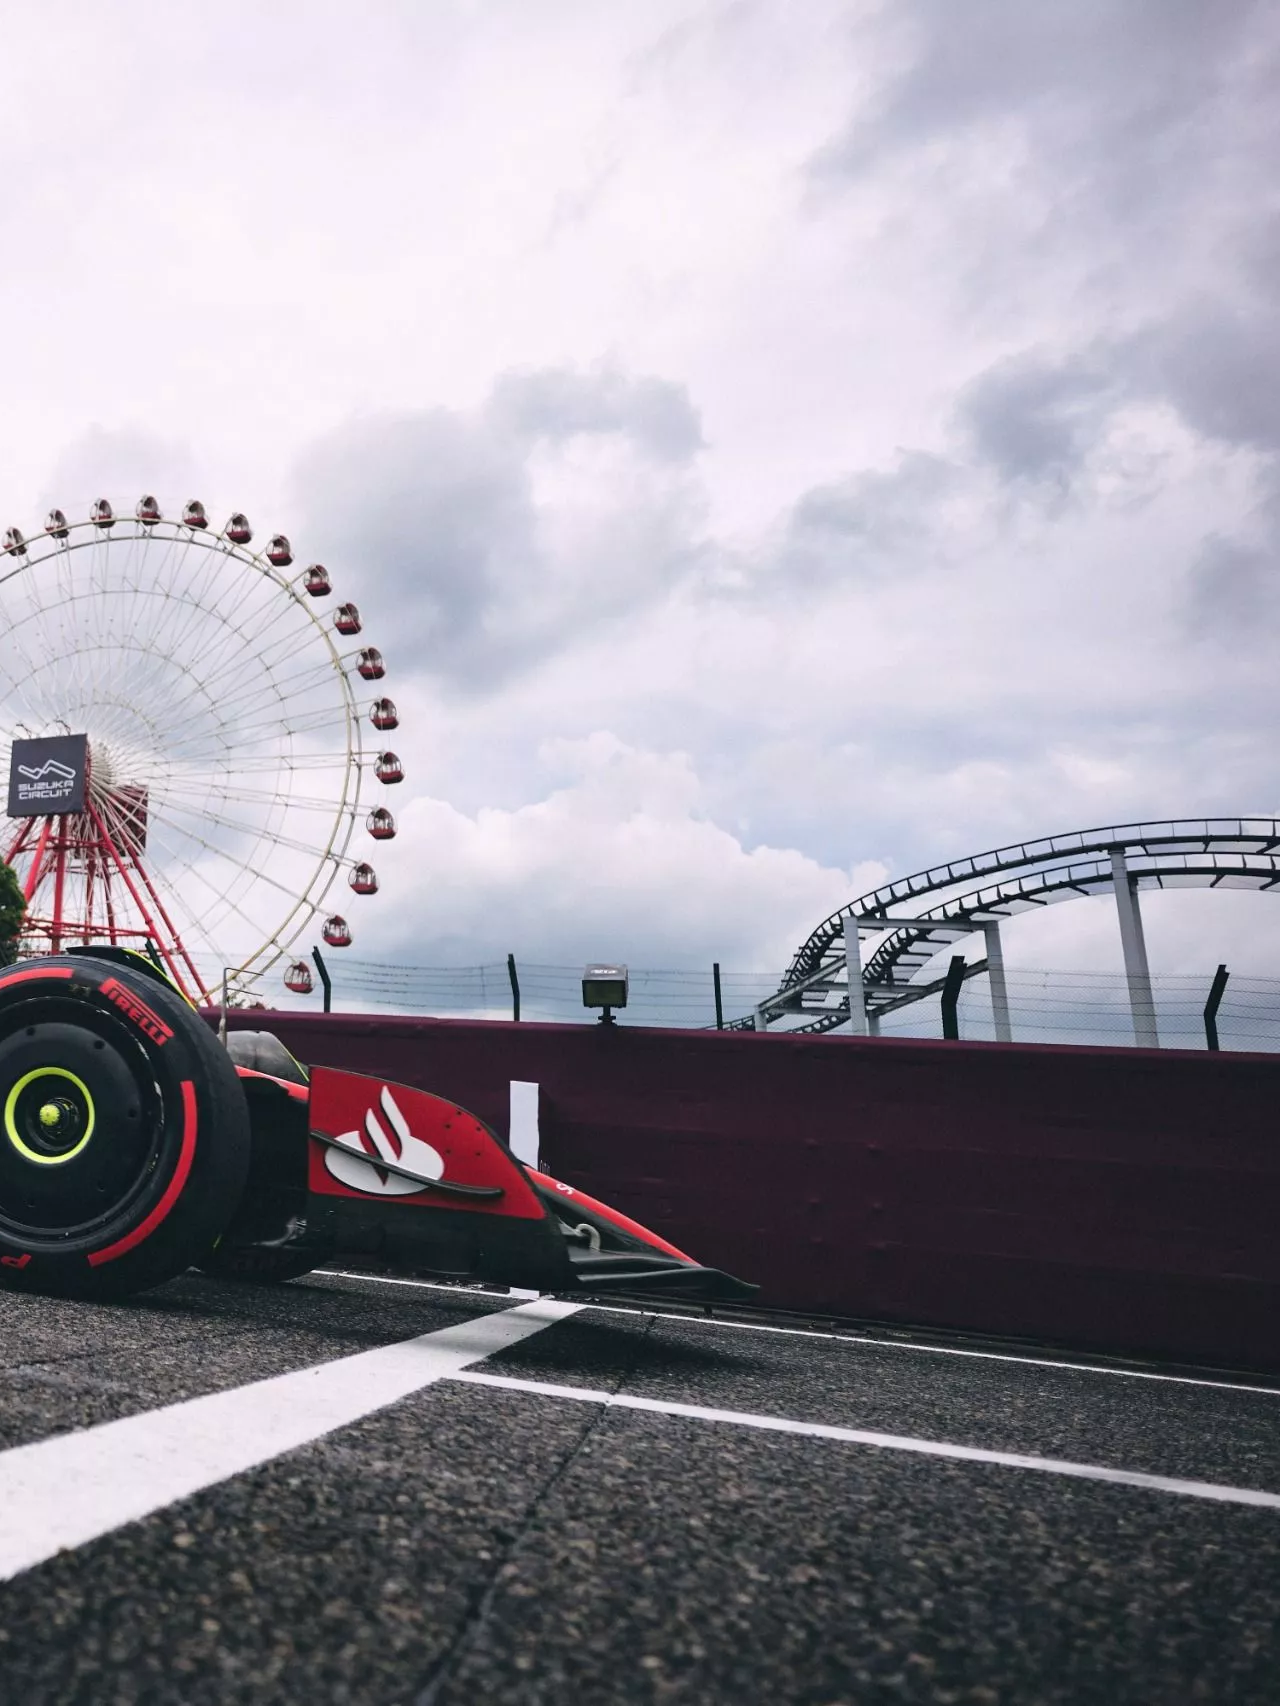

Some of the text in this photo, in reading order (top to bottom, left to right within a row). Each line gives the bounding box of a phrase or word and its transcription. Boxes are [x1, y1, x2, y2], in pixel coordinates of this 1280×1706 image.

[18, 780, 74, 791] SUZUKA
[18, 788, 72, 800] CIRCUIT
[99, 976, 175, 1047] PIRELLI
